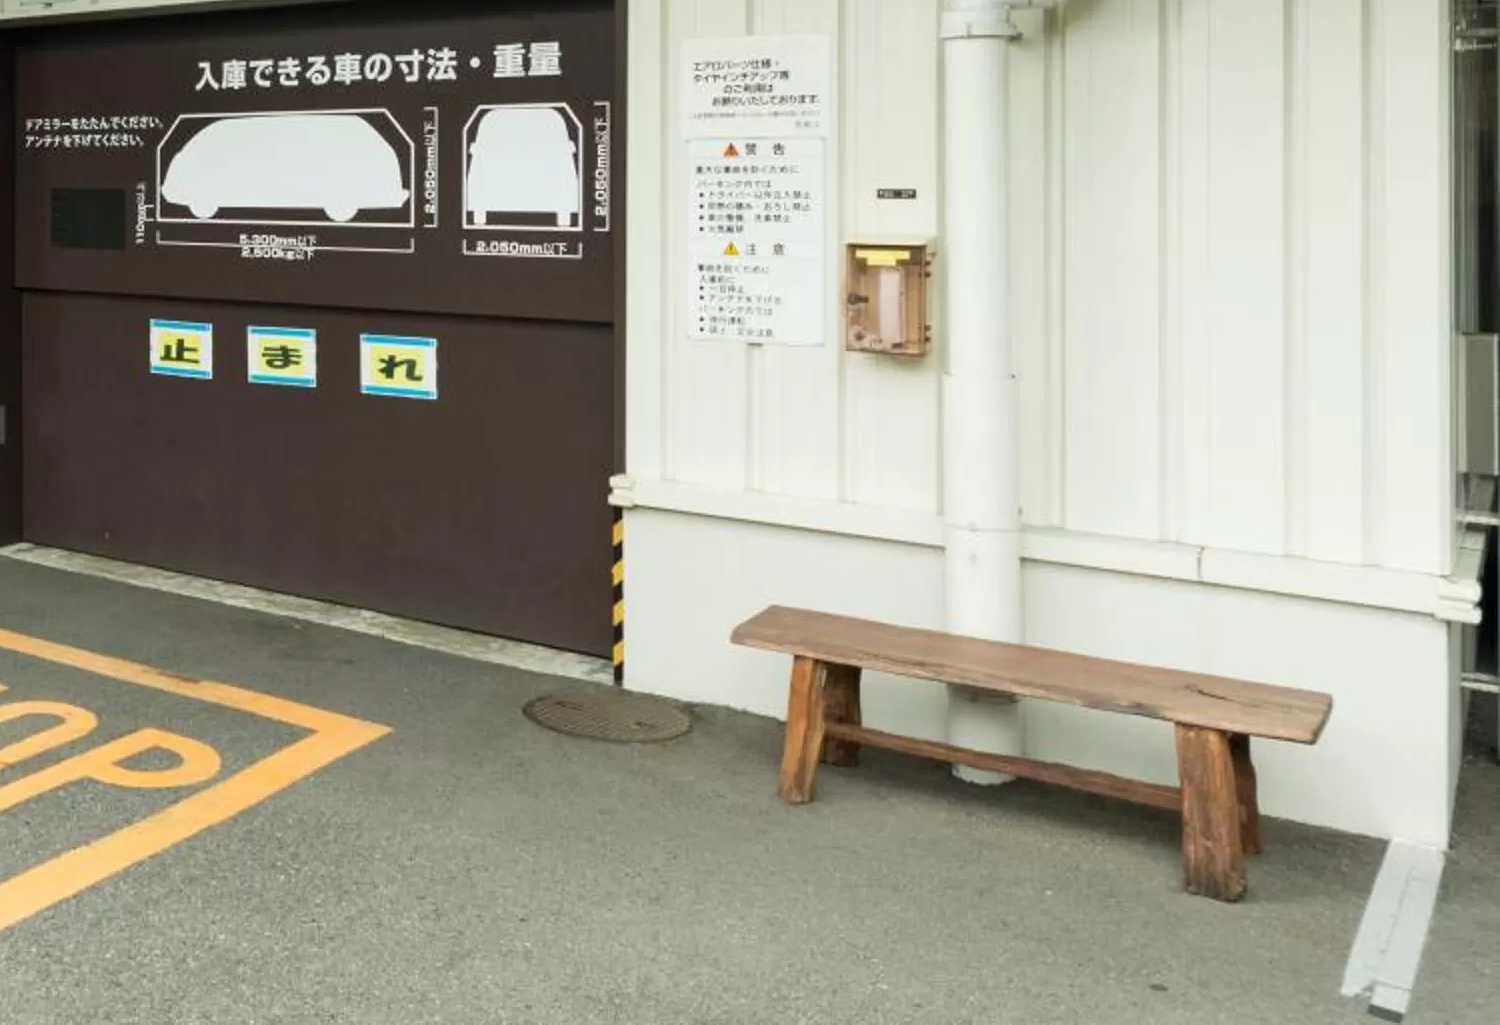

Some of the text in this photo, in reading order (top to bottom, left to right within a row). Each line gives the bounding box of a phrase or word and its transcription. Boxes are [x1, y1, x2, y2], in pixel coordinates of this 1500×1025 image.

[195, 41, 563, 91] 入庫できる車の寸法・重量
[25, 115, 164, 131] ドアミラーをたたんでください。
[159, 338, 424, 382] 止 ま れ
